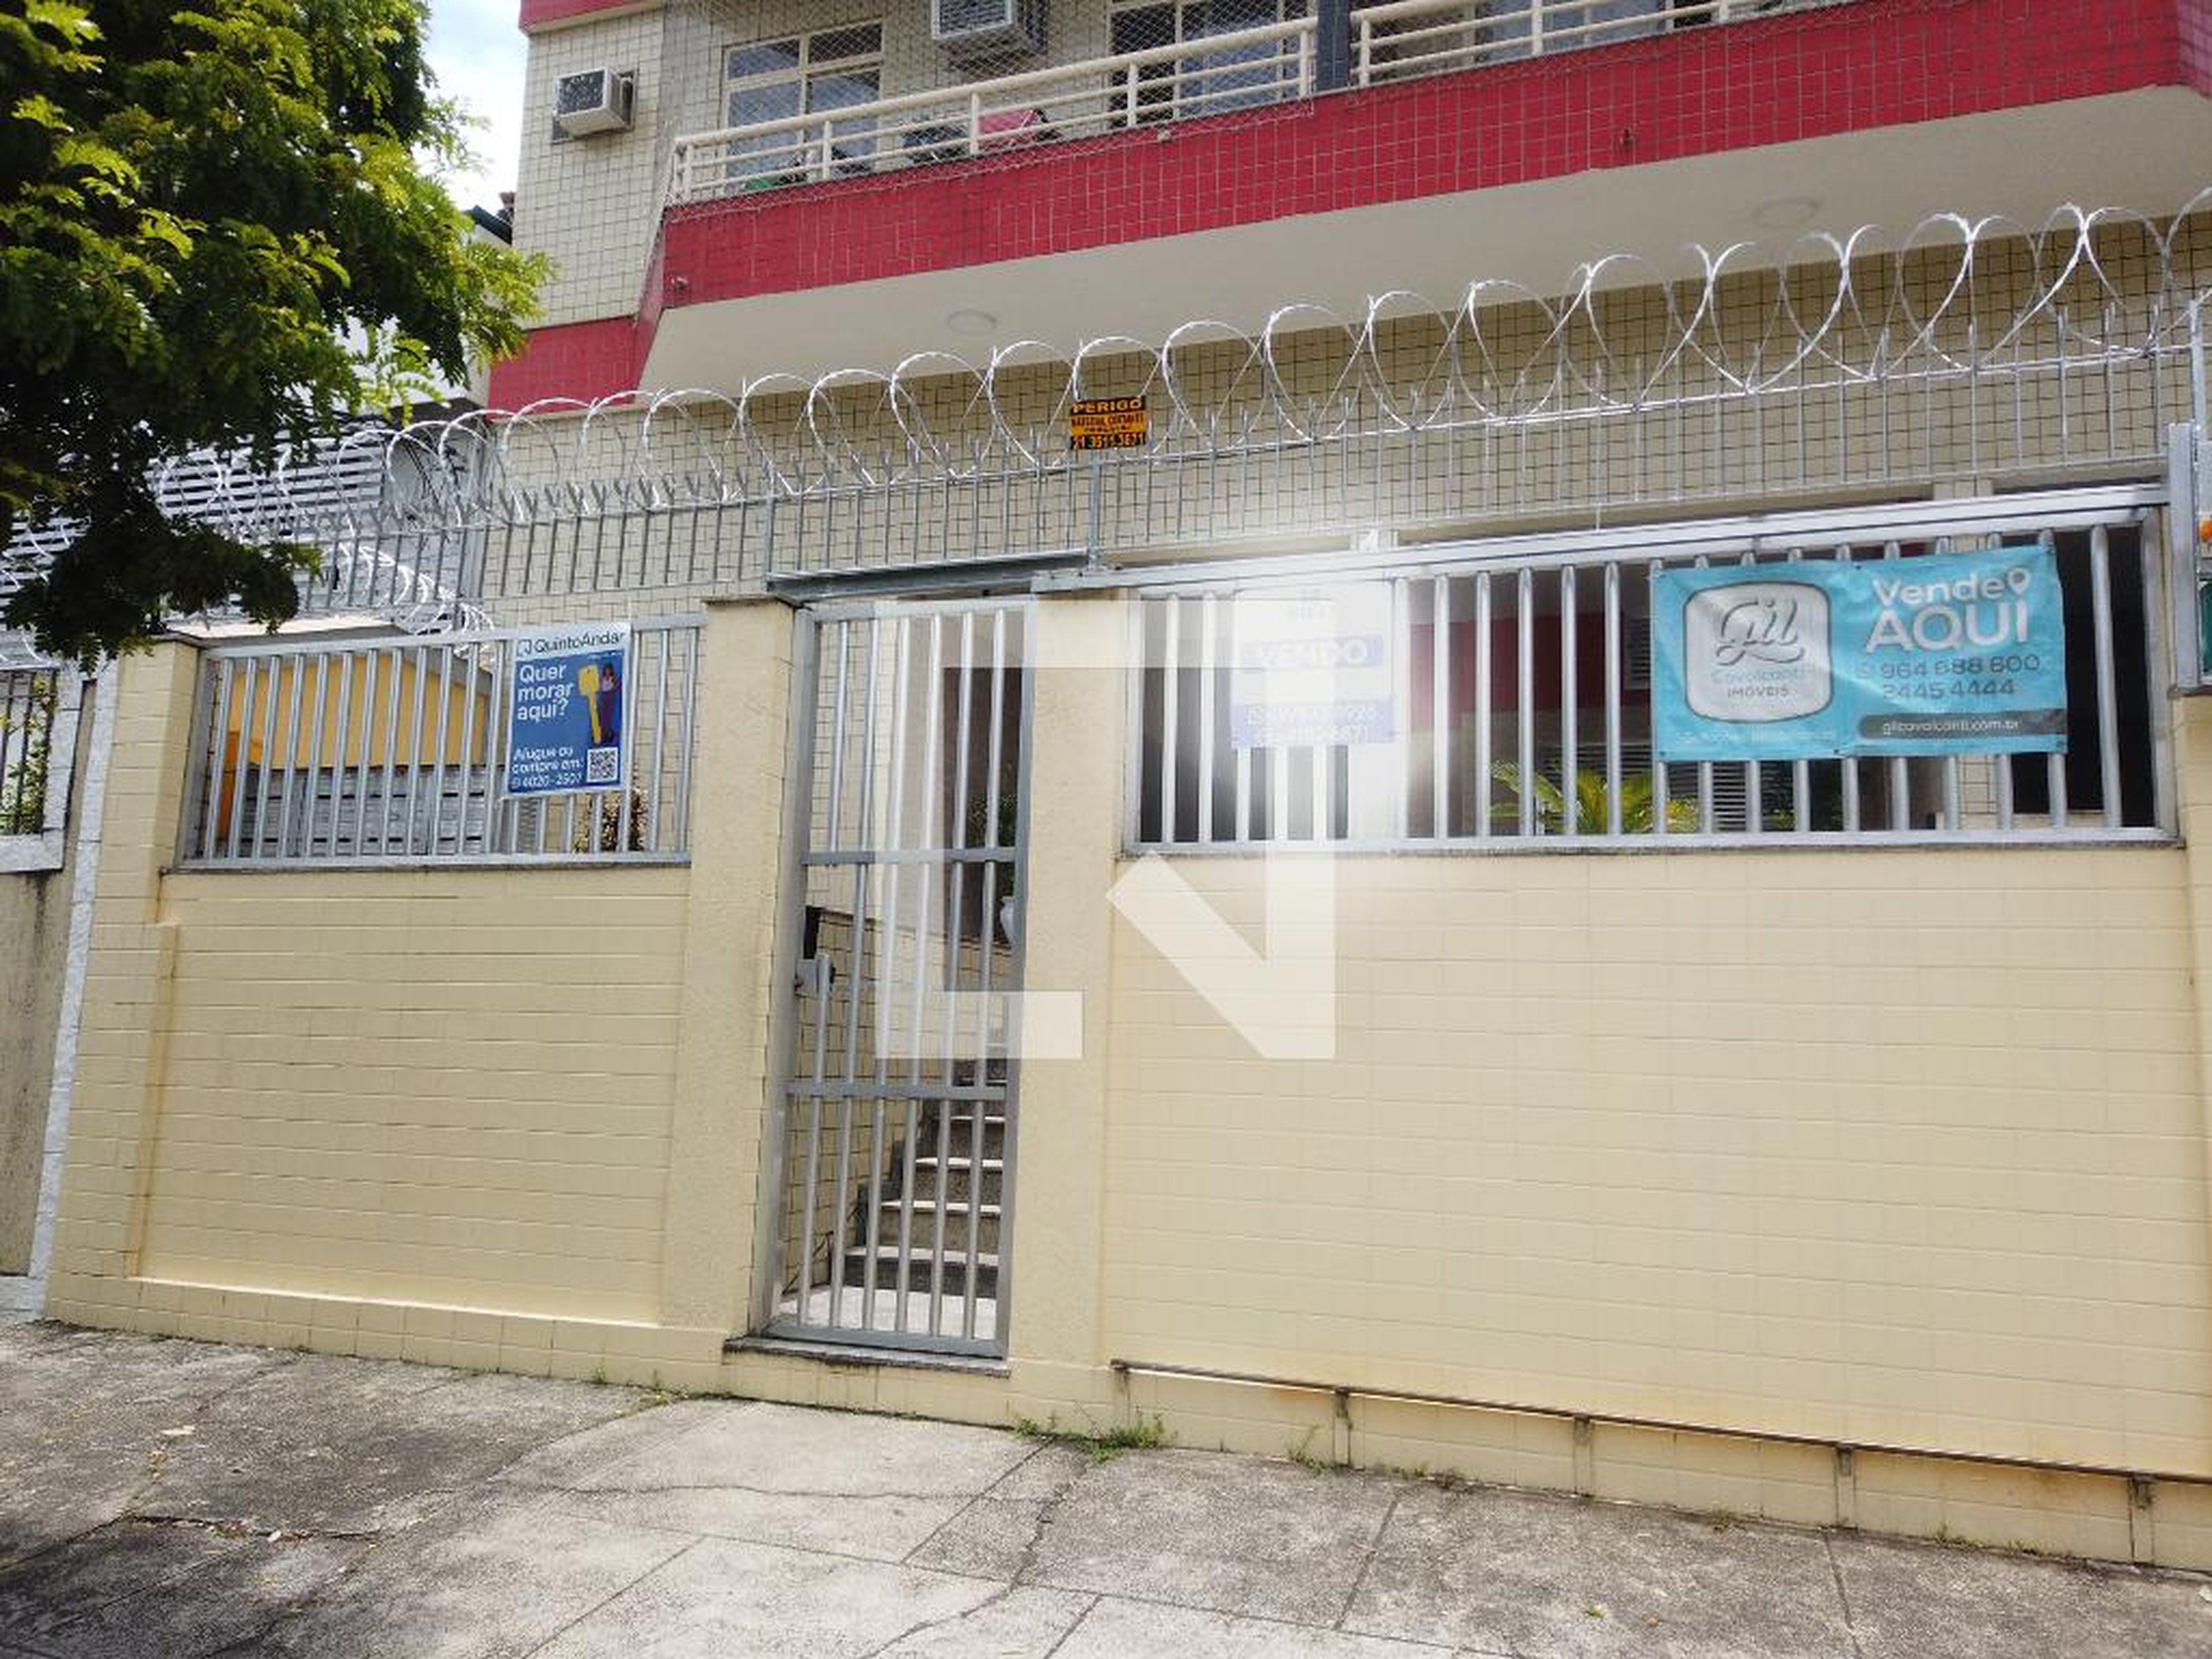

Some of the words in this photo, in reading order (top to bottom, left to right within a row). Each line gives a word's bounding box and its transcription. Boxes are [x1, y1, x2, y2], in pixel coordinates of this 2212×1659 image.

[1072, 399, 1142, 414] PERIGO
[1873, 573, 2006, 605] Vende
[1715, 599, 1805, 666] Gil
[1865, 599, 2029, 653] AQUI
[535, 631, 626, 653] QuintoAndar
[520, 664, 567, 683] Quer
[518, 684, 574, 702] morar
[1949, 679, 2016, 698] 4444
[518, 698, 569, 722] aqui?
